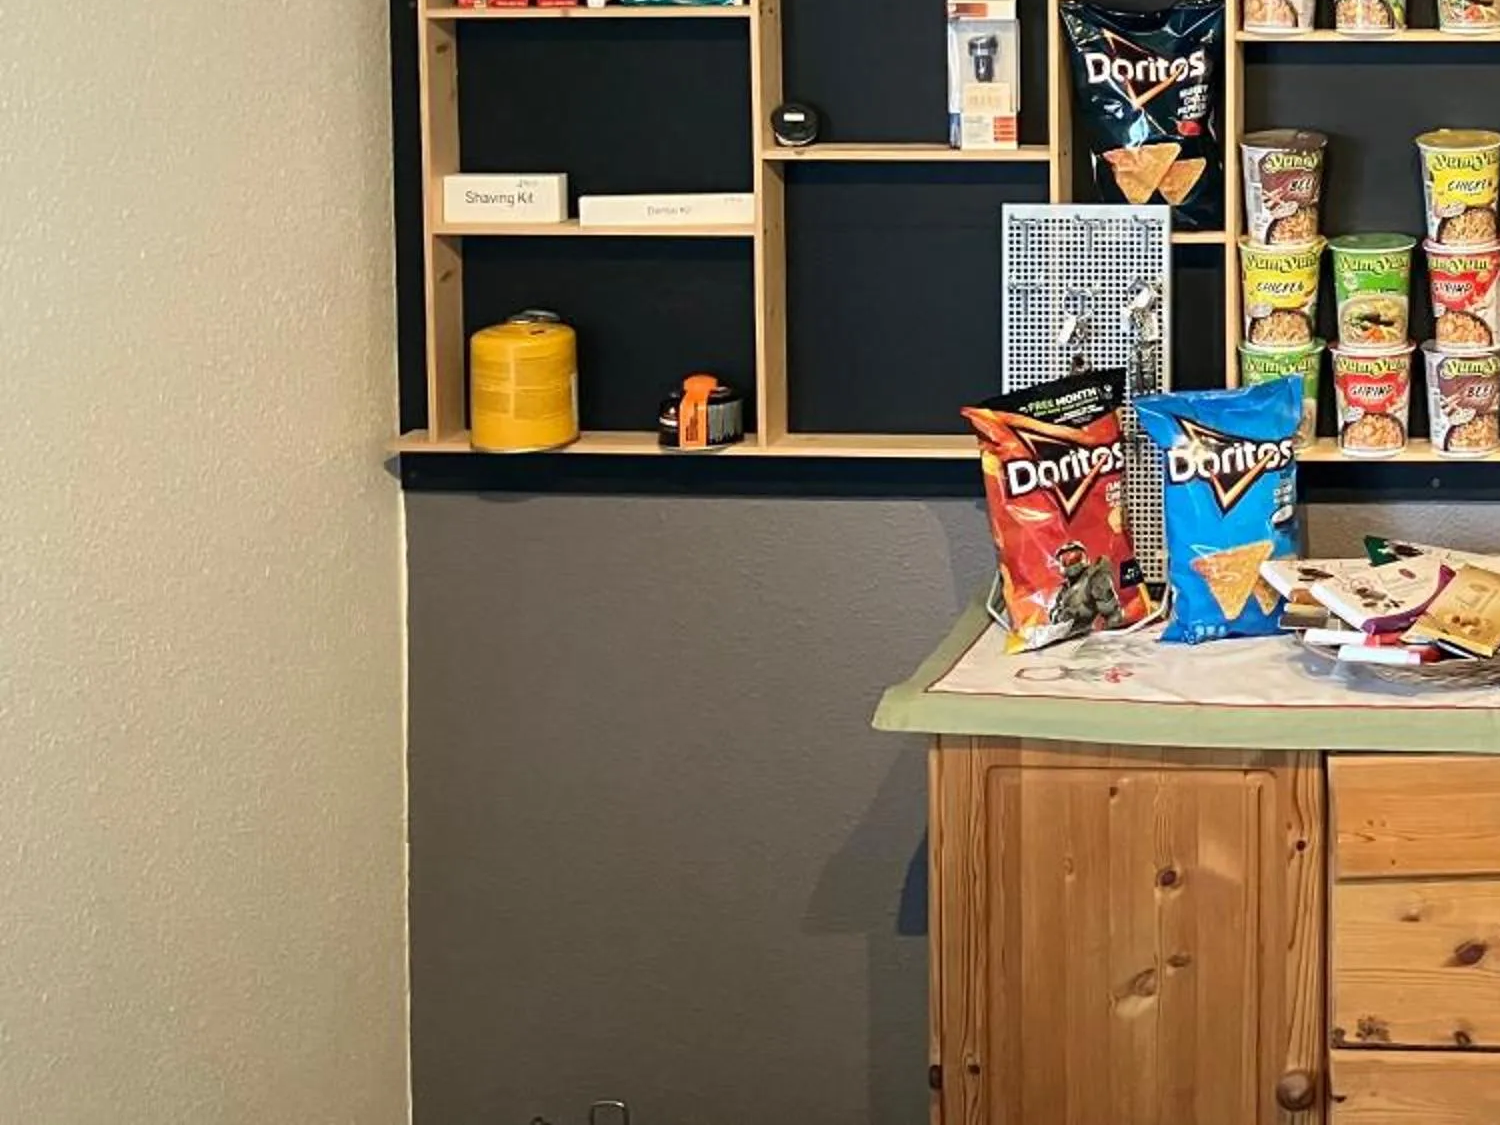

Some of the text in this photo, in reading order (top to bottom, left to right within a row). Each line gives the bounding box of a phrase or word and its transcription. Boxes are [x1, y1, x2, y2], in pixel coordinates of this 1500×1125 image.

[1083, 49, 1207, 84] Doritos
[465, 190, 534, 206] Shaving Kit
[1006, 441, 1125, 496] Doritos
[1167, 439, 1294, 483] Doritos
